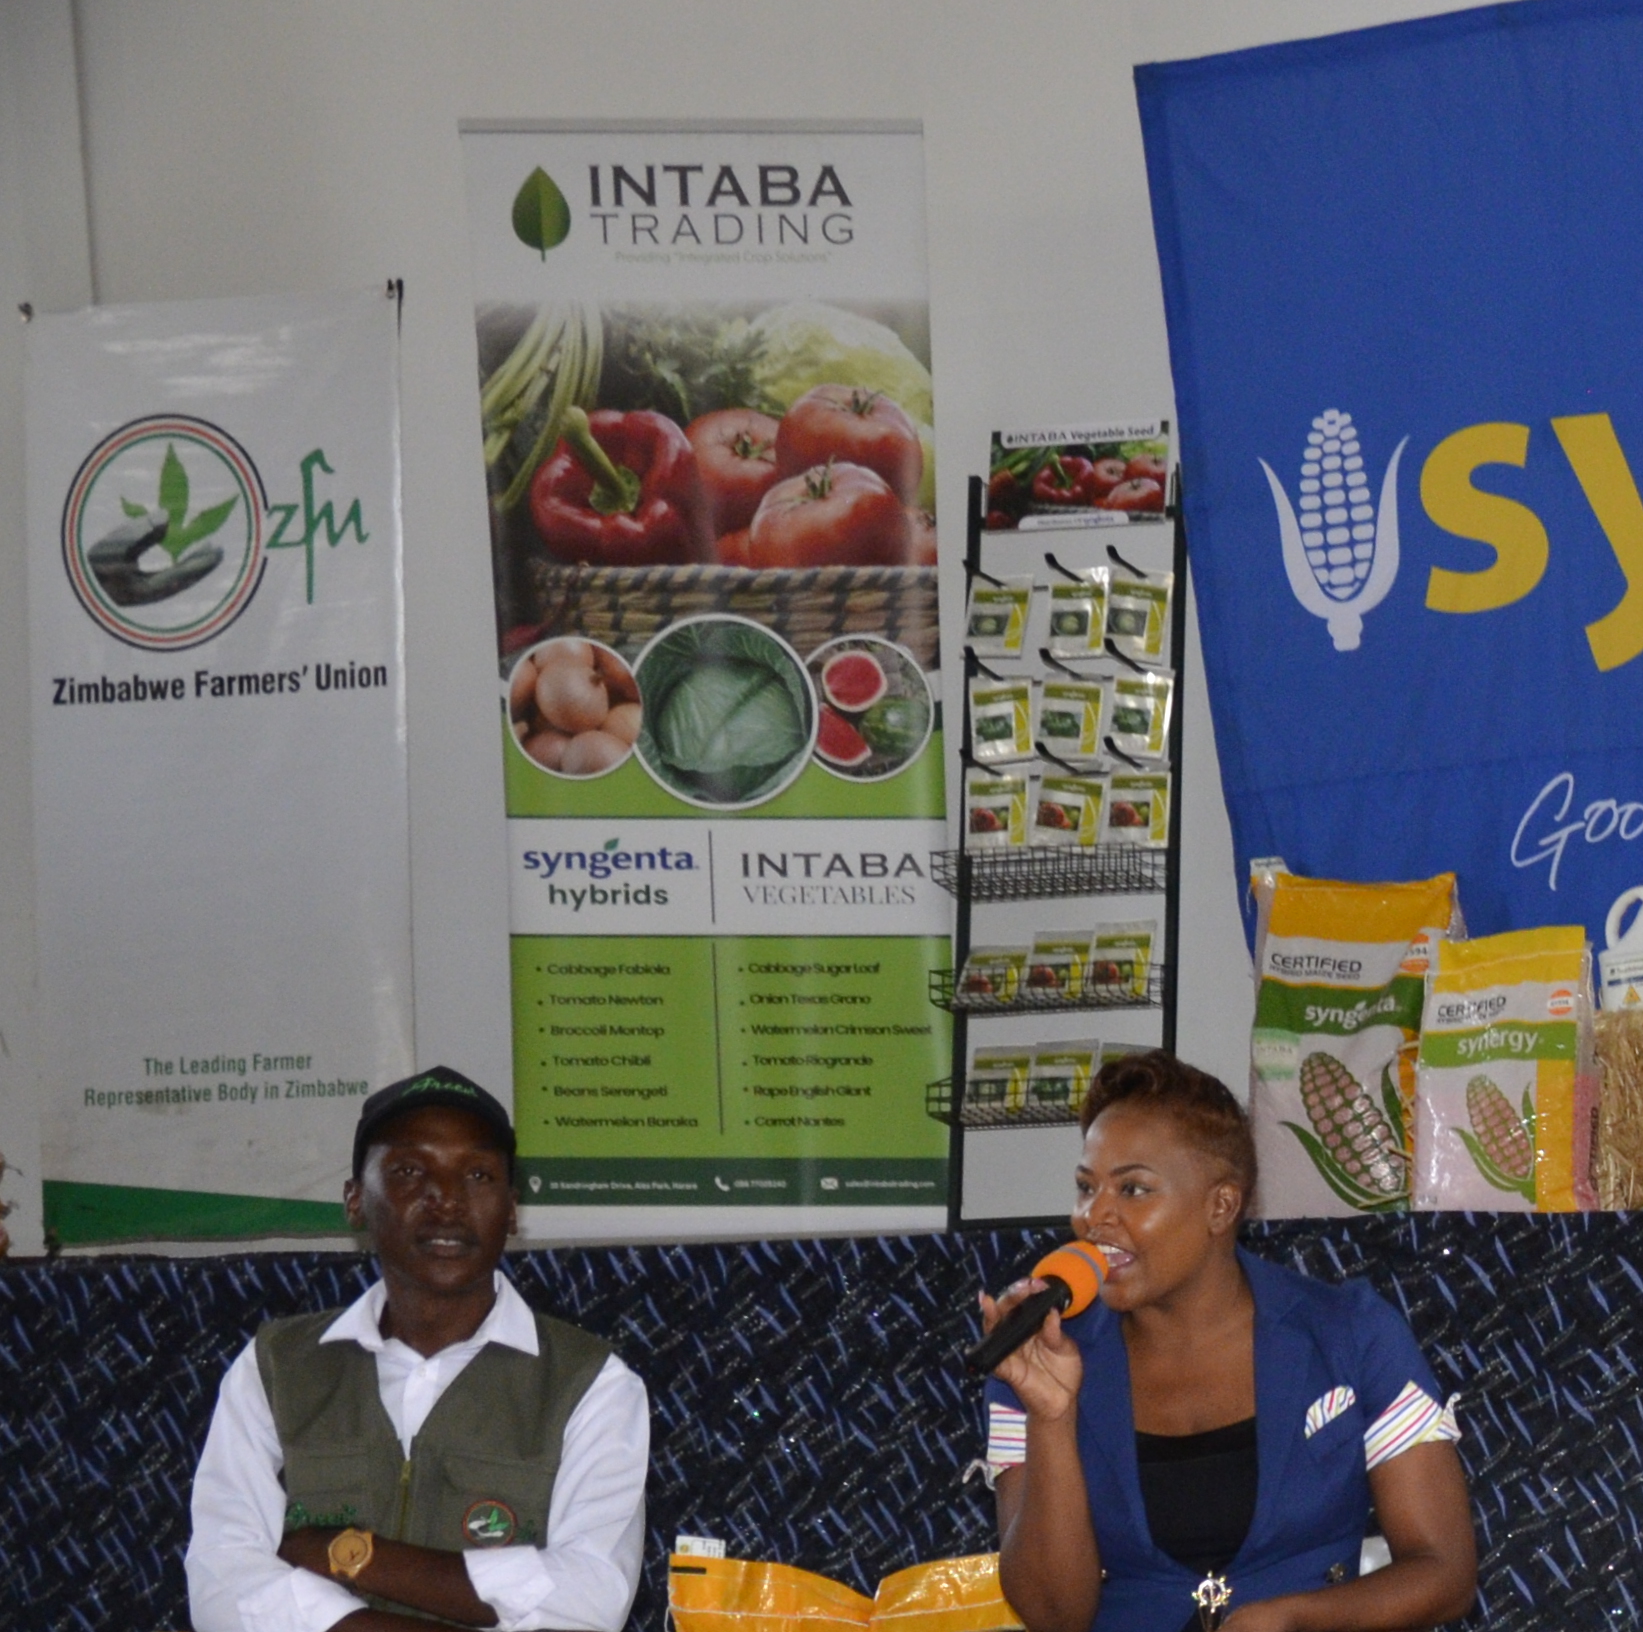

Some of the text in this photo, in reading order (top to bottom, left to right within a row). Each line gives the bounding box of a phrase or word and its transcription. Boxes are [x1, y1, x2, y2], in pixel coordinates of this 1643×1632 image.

[589, 164, 852, 207] INTABA
[590, 213, 854, 244] TRADING
[1014, 425, 1154, 444] INTABA Vegetable Seed
[53, 663, 387, 705] Zimbabwe Farmers' Union
[523, 847, 694, 878] syngenta
[741, 852, 925, 878] INTABA
[549, 884, 669, 910] hybrids
[744, 887, 915, 904] VEGETABLES
[1271, 953, 1362, 973] CERTIFIED
[1458, 1029, 1538, 1055] synergy
[144, 1053, 312, 1078] The Leading Farmer
[84, 1078, 369, 1107] Representative Body in Zimbabwe
